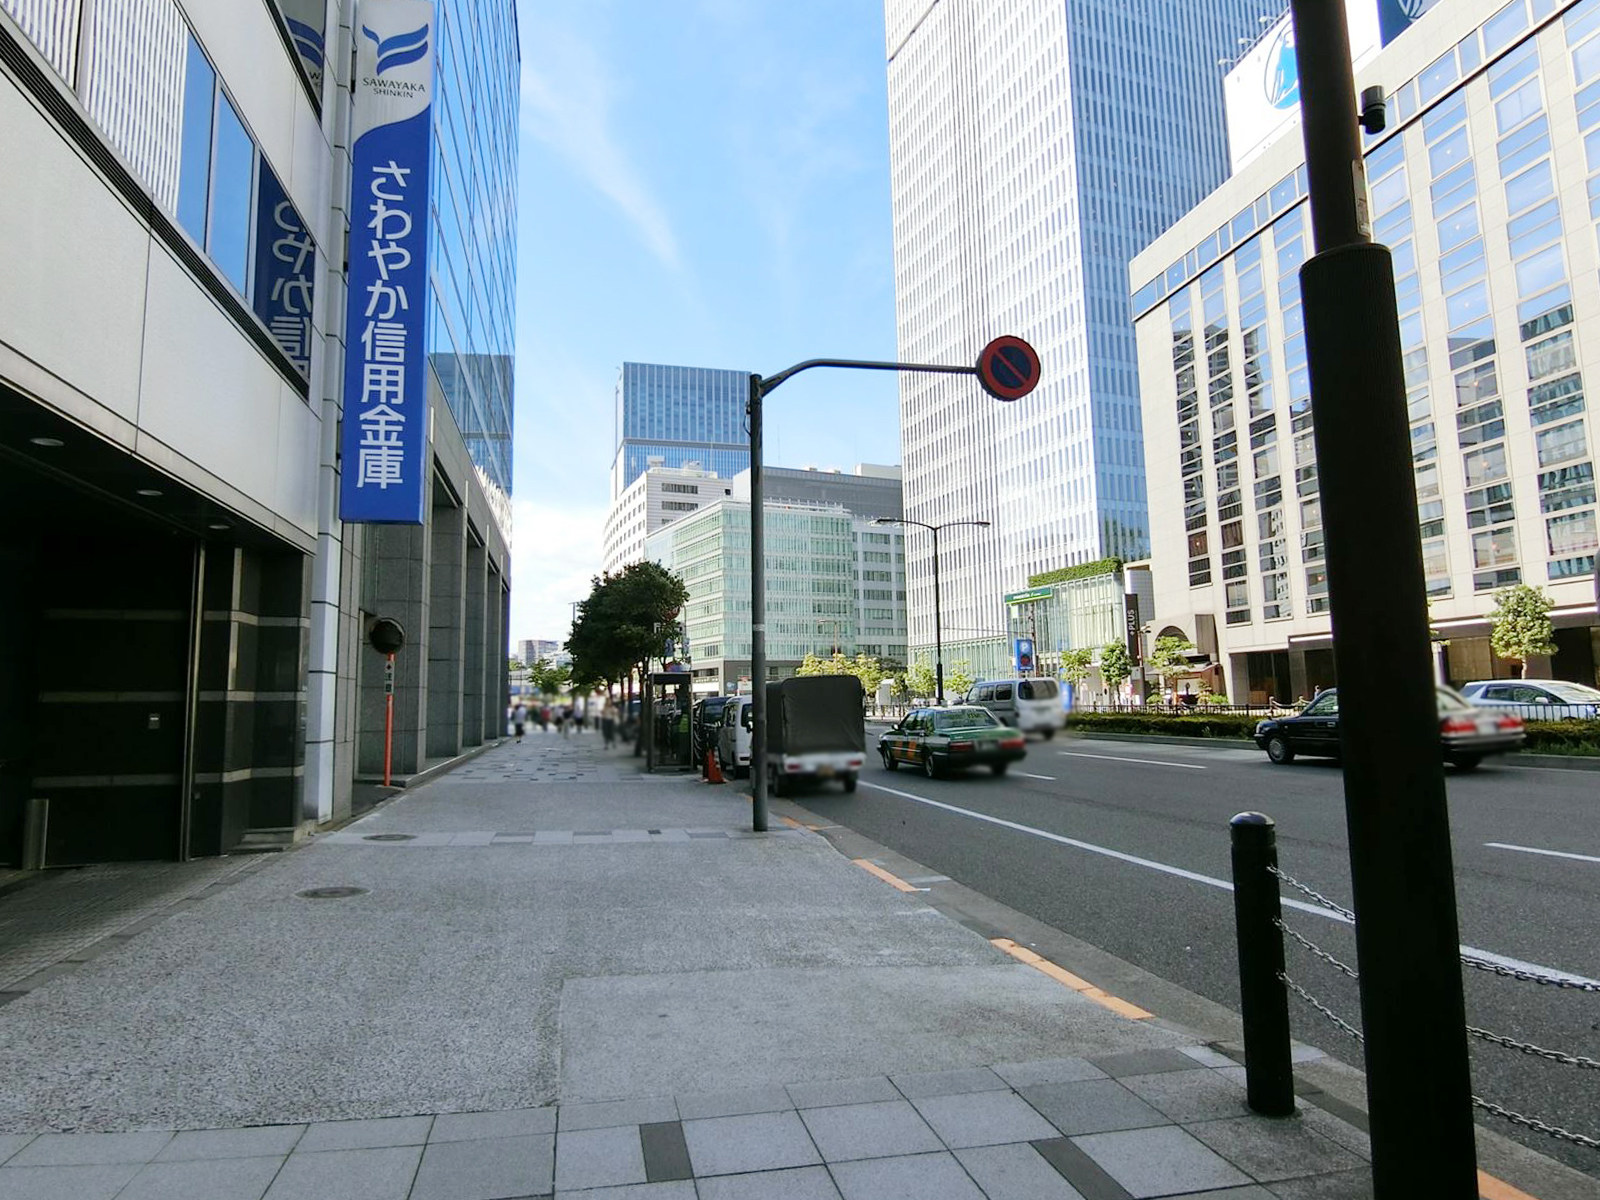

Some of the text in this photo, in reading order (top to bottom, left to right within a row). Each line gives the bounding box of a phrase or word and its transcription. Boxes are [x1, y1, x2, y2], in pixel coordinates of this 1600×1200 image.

[362, 77, 426, 92] SAWAYAKA
[373, 88, 413, 98] SHINKIN
[356, 160, 413, 490] さわやか信用金庫
